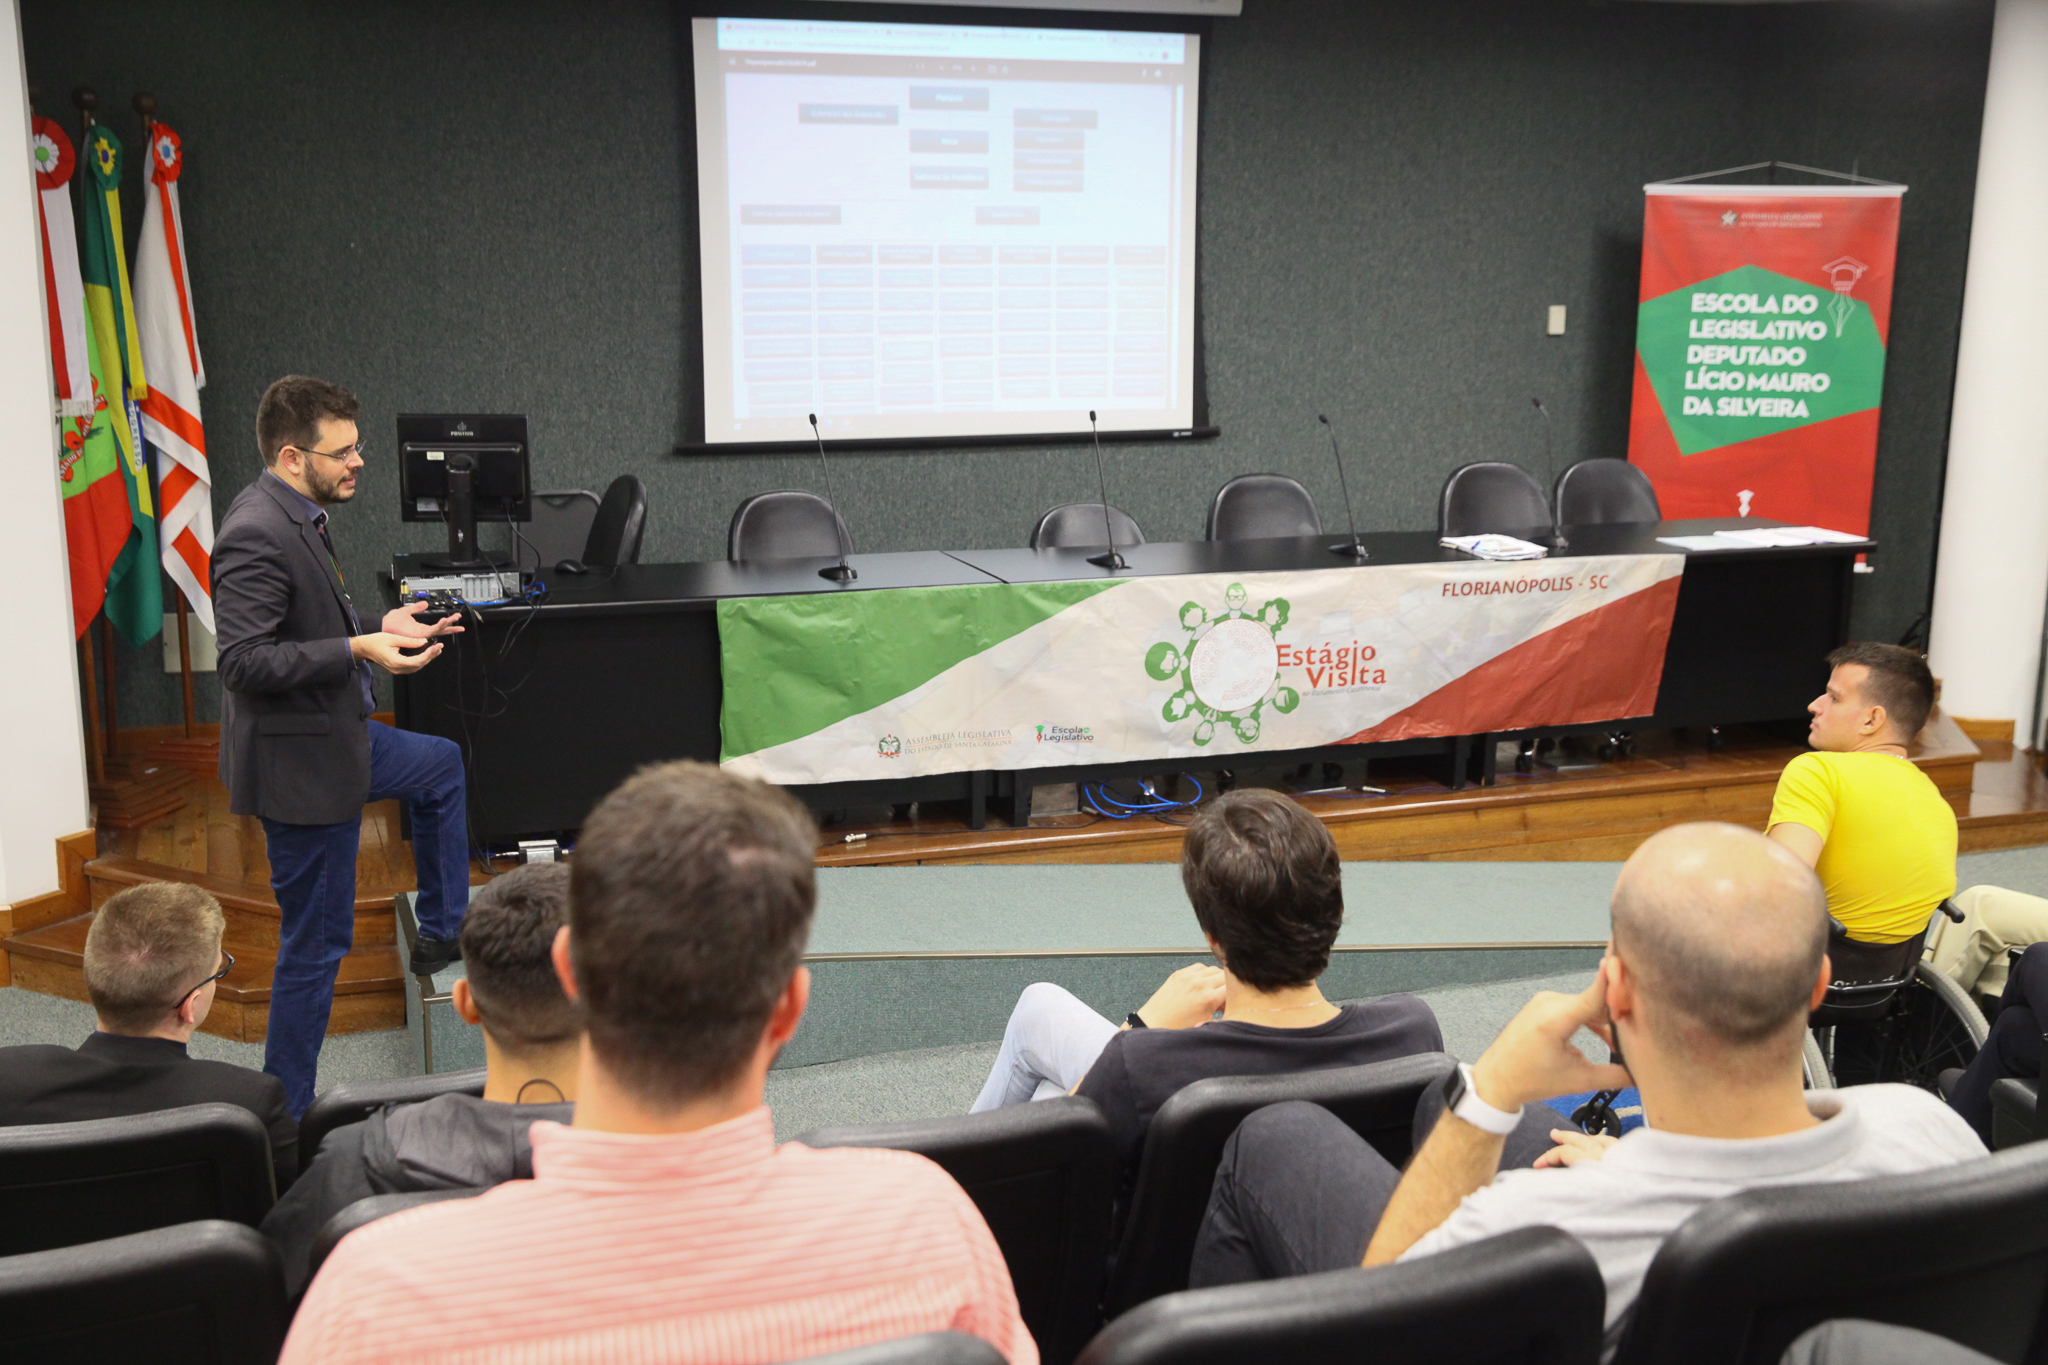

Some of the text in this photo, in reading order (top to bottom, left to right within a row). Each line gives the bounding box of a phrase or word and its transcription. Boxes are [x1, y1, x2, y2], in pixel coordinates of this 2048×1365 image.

[1691, 292, 1819, 315] ESCOLA DO
[1689, 318, 1828, 341] LEGISLATIVO
[1686, 344, 1807, 366] DEPUTADO
[1684, 365, 1831, 393] LÍCIO MAURO
[1682, 396, 1810, 418] DA SILVEIRA
[1442, 575, 1573, 597] FLORIANÓPOLIS
[1589, 575, 1609, 590] SC
[1277, 640, 1376, 670] Estágio
[905, 729, 1012, 745] ASSEMBLEIA LEGISLATIVA
[1044, 734, 1094, 743] Legislativo
[1052, 726, 1083, 734] Escola
[954, 740, 976, 748] SANTA
[977, 739, 1012, 747] CATARINA
